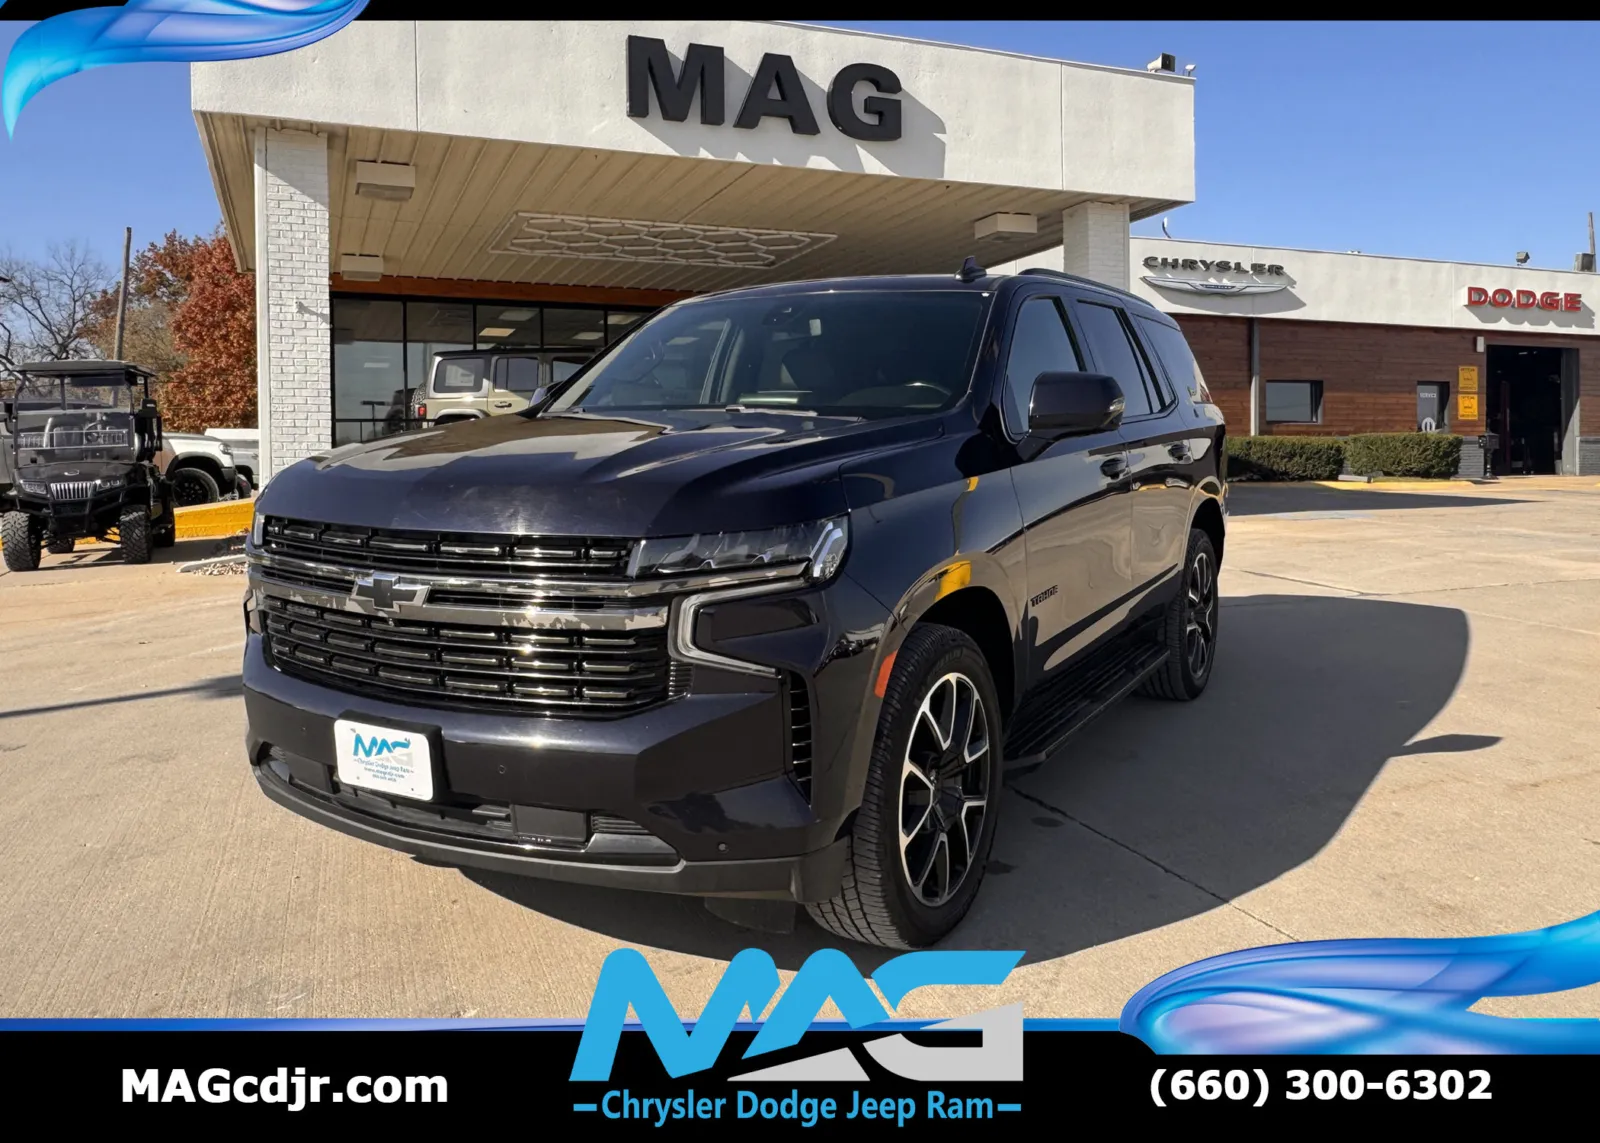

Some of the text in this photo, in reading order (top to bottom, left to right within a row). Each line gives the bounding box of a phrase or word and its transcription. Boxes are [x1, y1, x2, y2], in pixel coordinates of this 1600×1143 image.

[626, 35, 902, 141] MAG
[1143, 256, 1284, 275] CHRYSLER
[1467, 286, 1582, 312] DODGE
[1030, 584, 1058, 607] TAHOE
